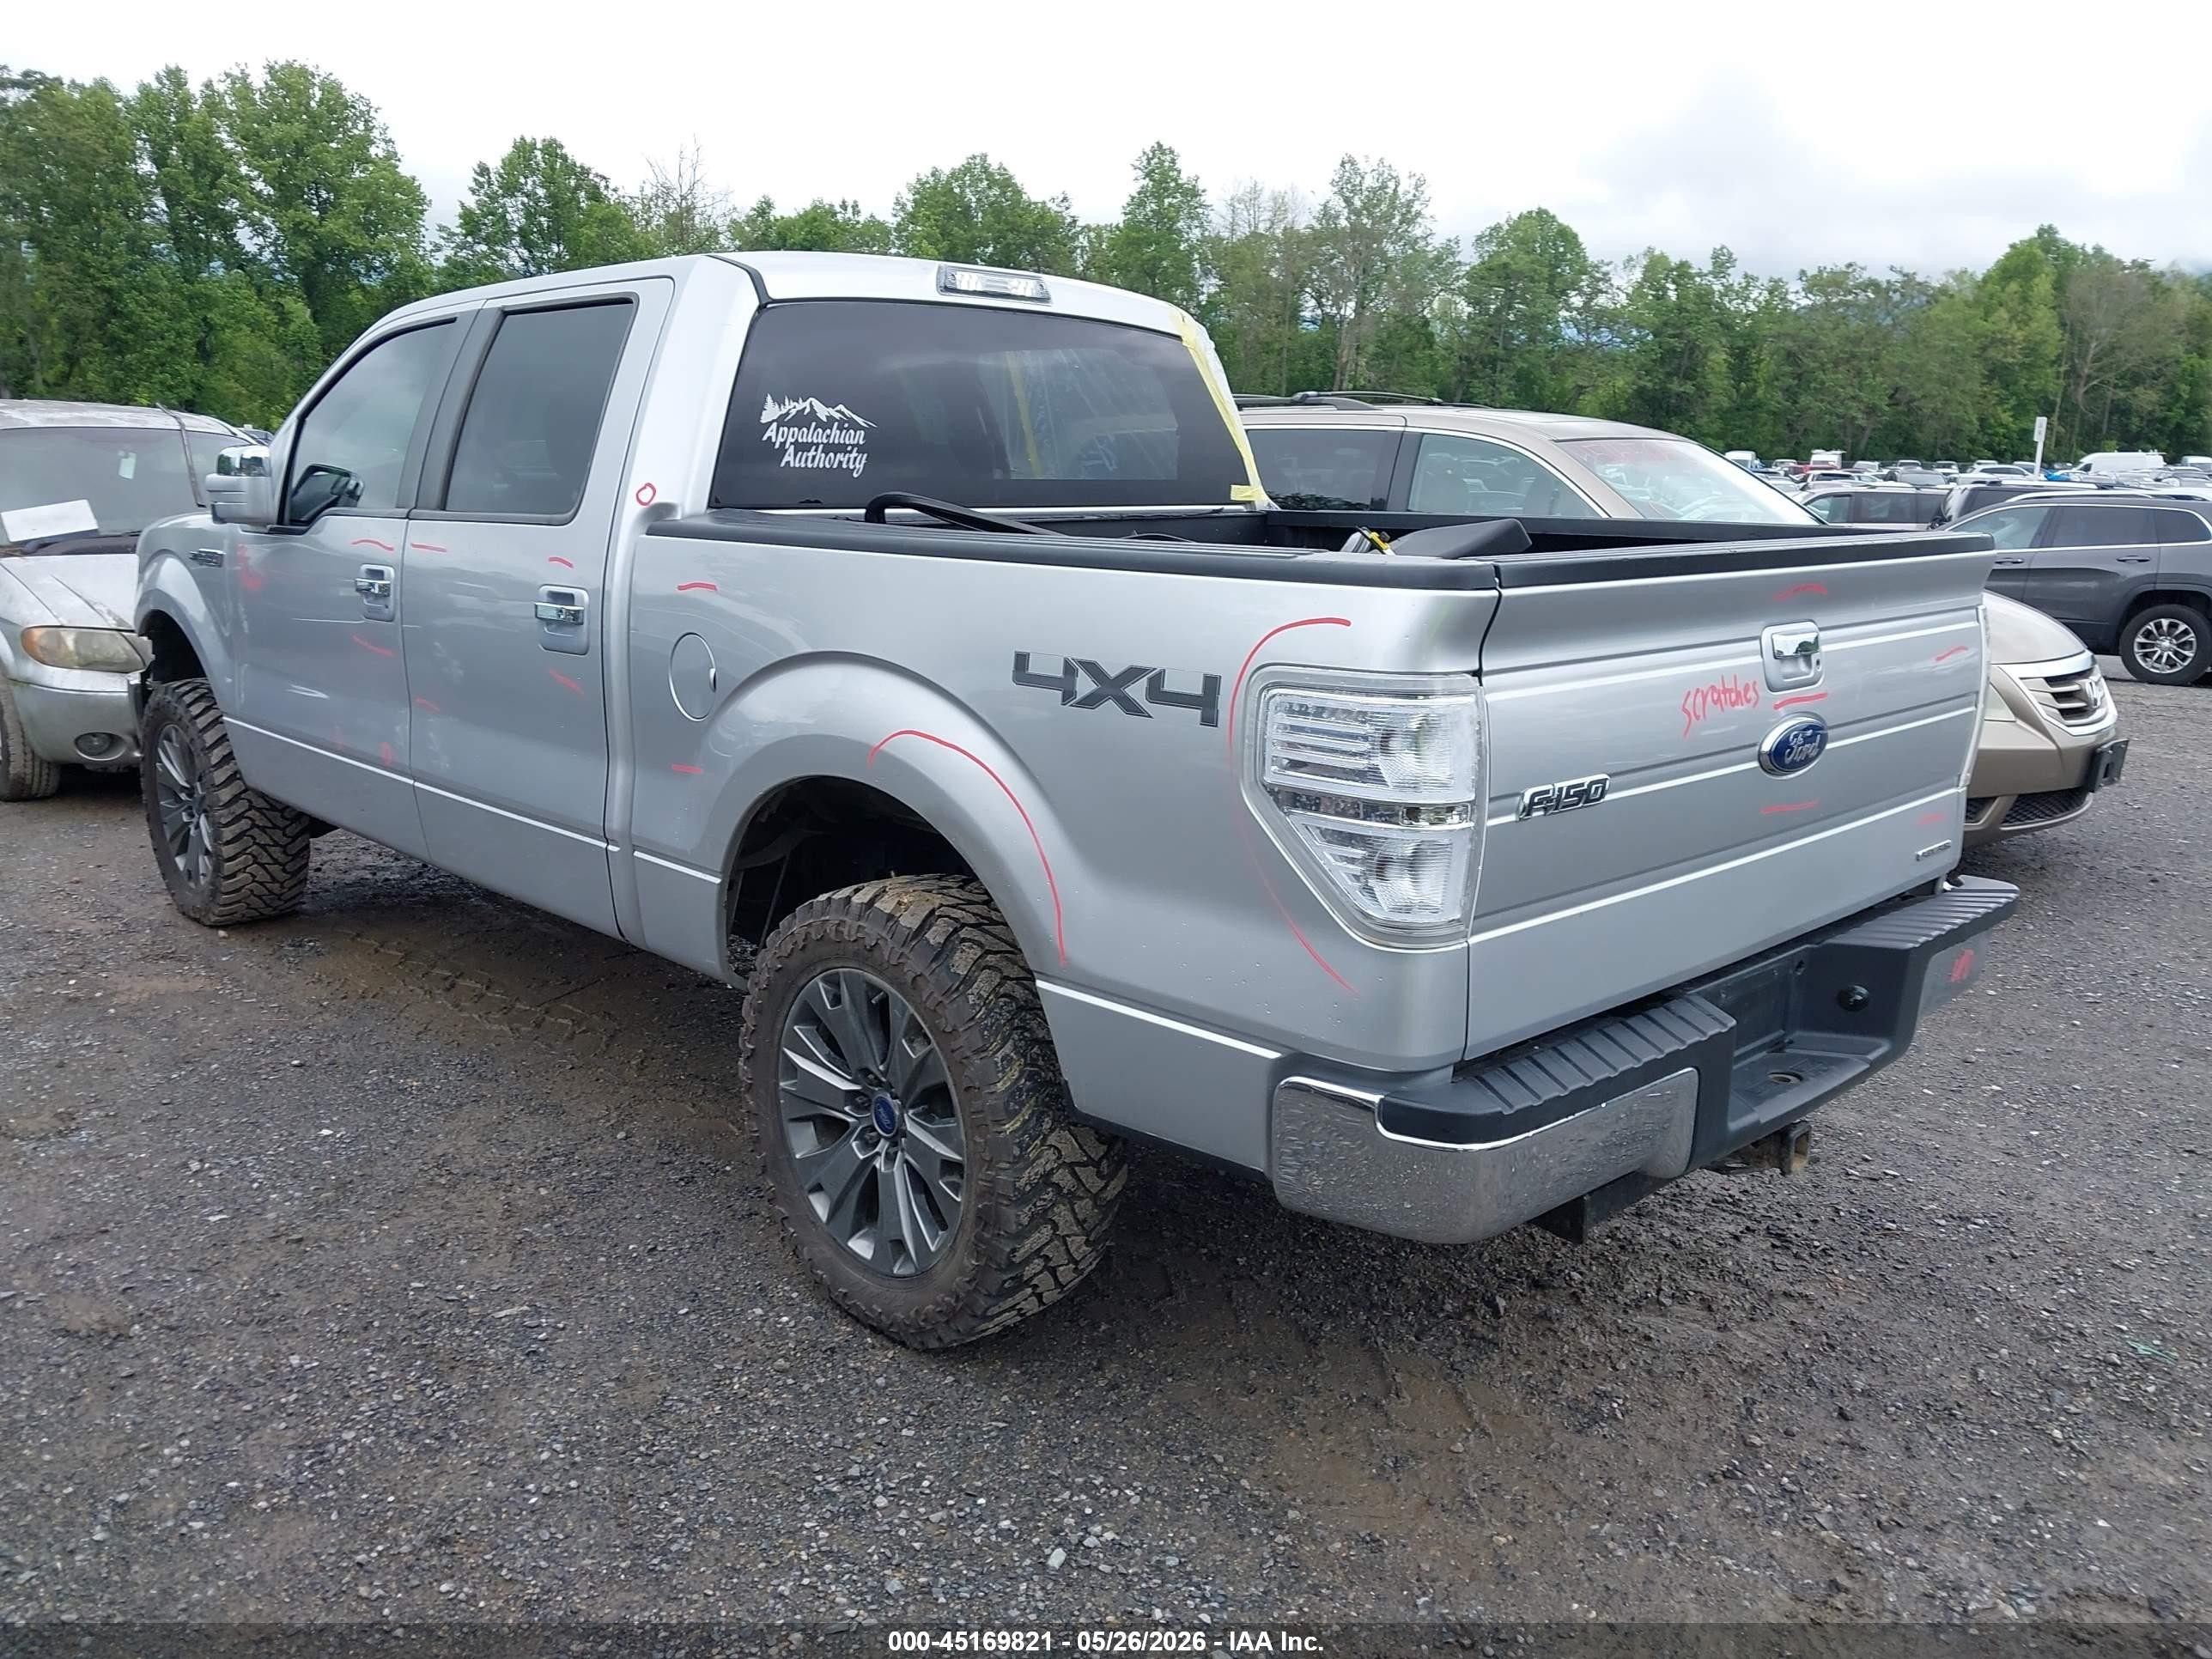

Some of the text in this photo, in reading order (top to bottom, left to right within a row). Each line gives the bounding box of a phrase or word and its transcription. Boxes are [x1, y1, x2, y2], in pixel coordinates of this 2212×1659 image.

[762, 421, 866, 450] Appalachian
[780, 443, 868, 478] Authority
[1680, 673, 1760, 742] scratches
[1784, 729, 1821, 764] Ford
